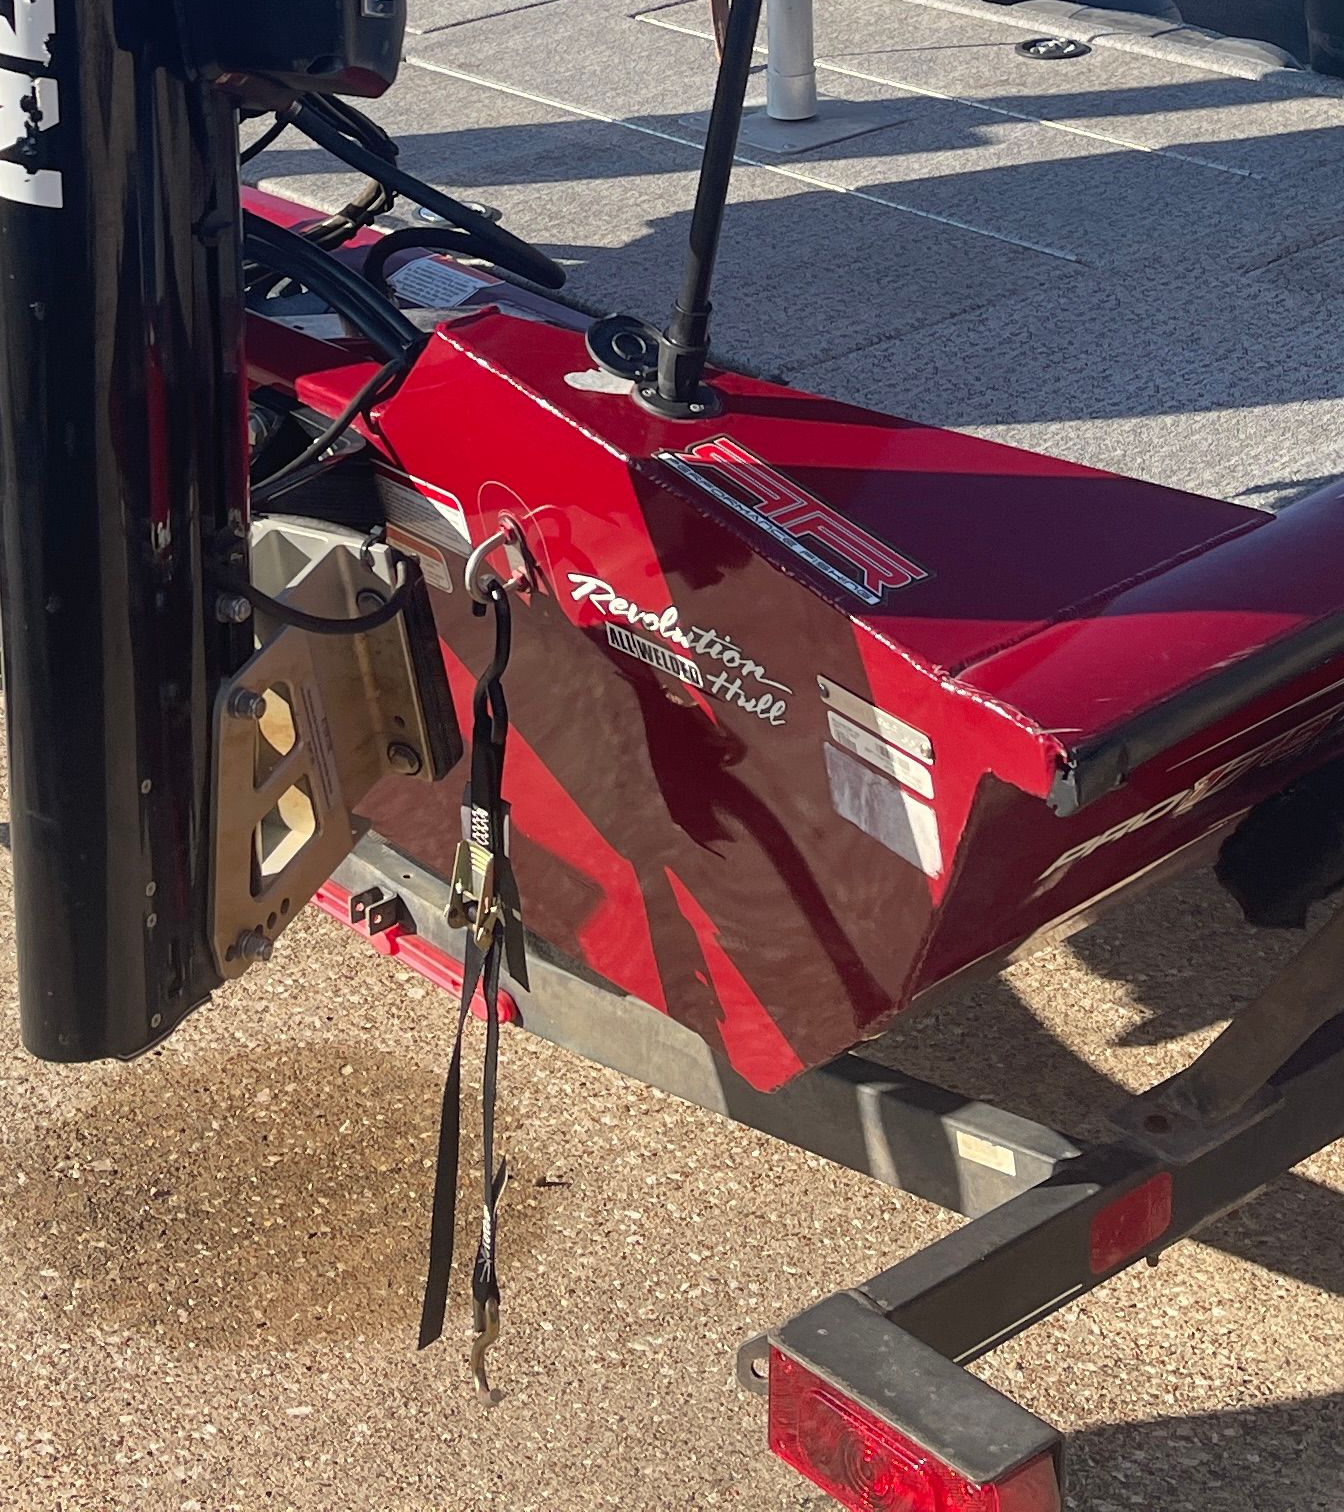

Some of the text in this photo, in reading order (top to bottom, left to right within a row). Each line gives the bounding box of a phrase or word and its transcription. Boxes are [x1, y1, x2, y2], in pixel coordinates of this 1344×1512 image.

[665, 456, 873, 601] PERFORMANCE FISHING
[567, 572, 793, 695] Revolution
[609, 625, 637, 658] ALL
[706, 670, 786, 726] Hull
[1035, 788, 1195, 882] PRO
